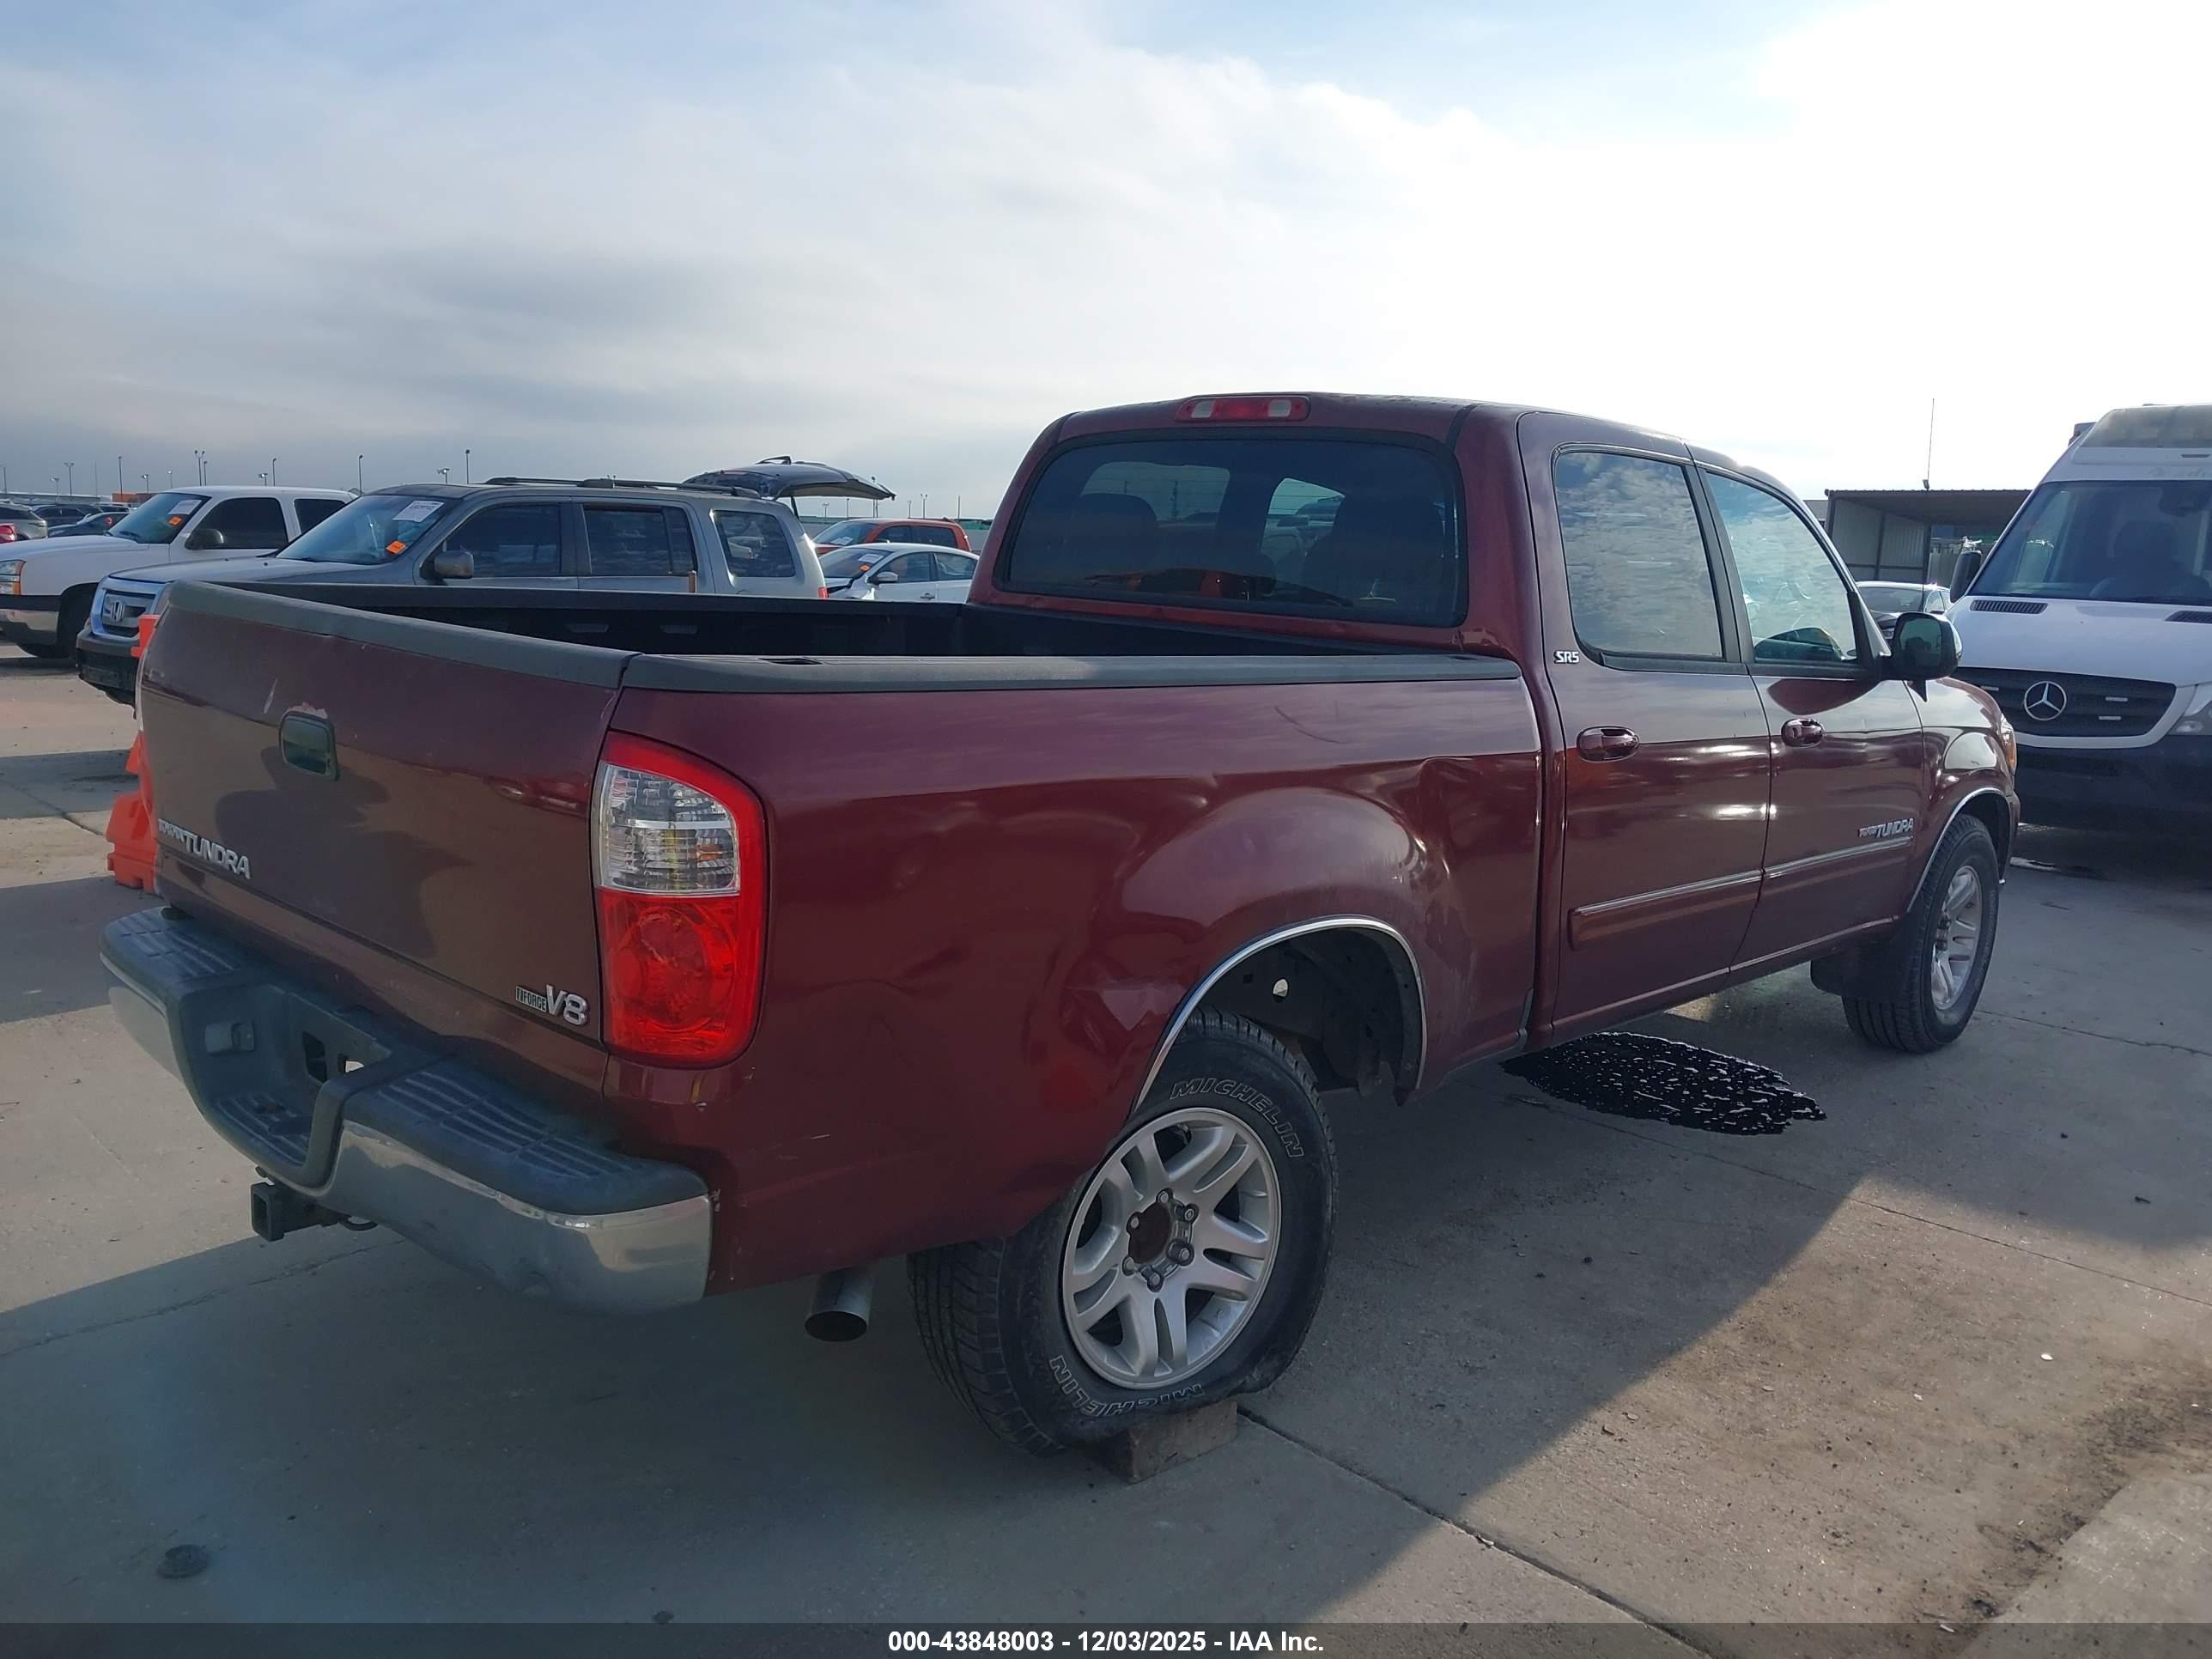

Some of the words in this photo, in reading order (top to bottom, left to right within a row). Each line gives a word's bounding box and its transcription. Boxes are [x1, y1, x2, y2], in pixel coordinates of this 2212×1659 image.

[1553, 650, 1580, 664] SR5
[1876, 817, 1914, 839] TUNDRA
[184, 830, 251, 879] TUNDRA
[546, 984, 587, 1025] V8
[1170, 1078, 1304, 1158] MICHELIN
[1049, 1355, 1204, 1417] MICHELIN
